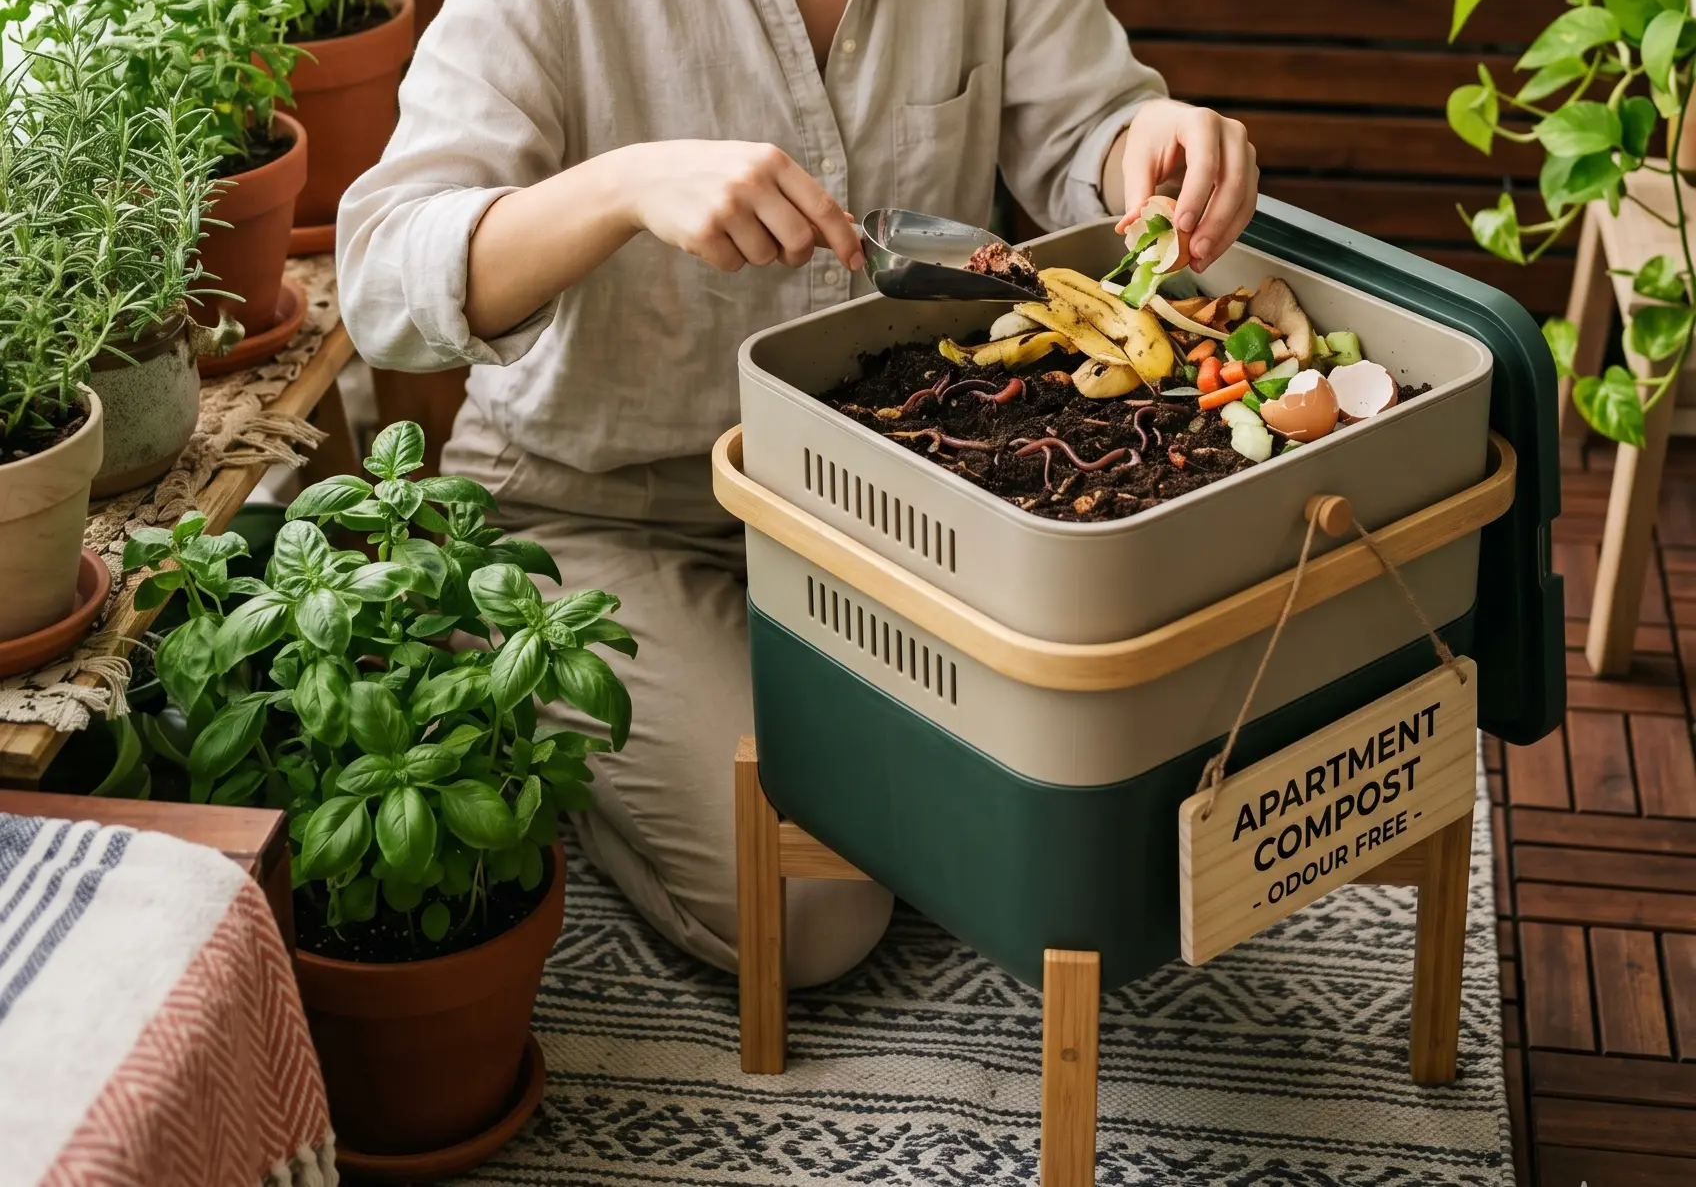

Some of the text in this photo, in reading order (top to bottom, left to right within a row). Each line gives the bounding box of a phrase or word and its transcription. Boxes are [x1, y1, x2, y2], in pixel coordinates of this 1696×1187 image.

[1232, 702, 1440, 842] APARTMENT
[1254, 756, 1420, 872] COMPOST
[1268, 845, 1348, 904] ODOUR
[1355, 810, 1407, 857] FREE
